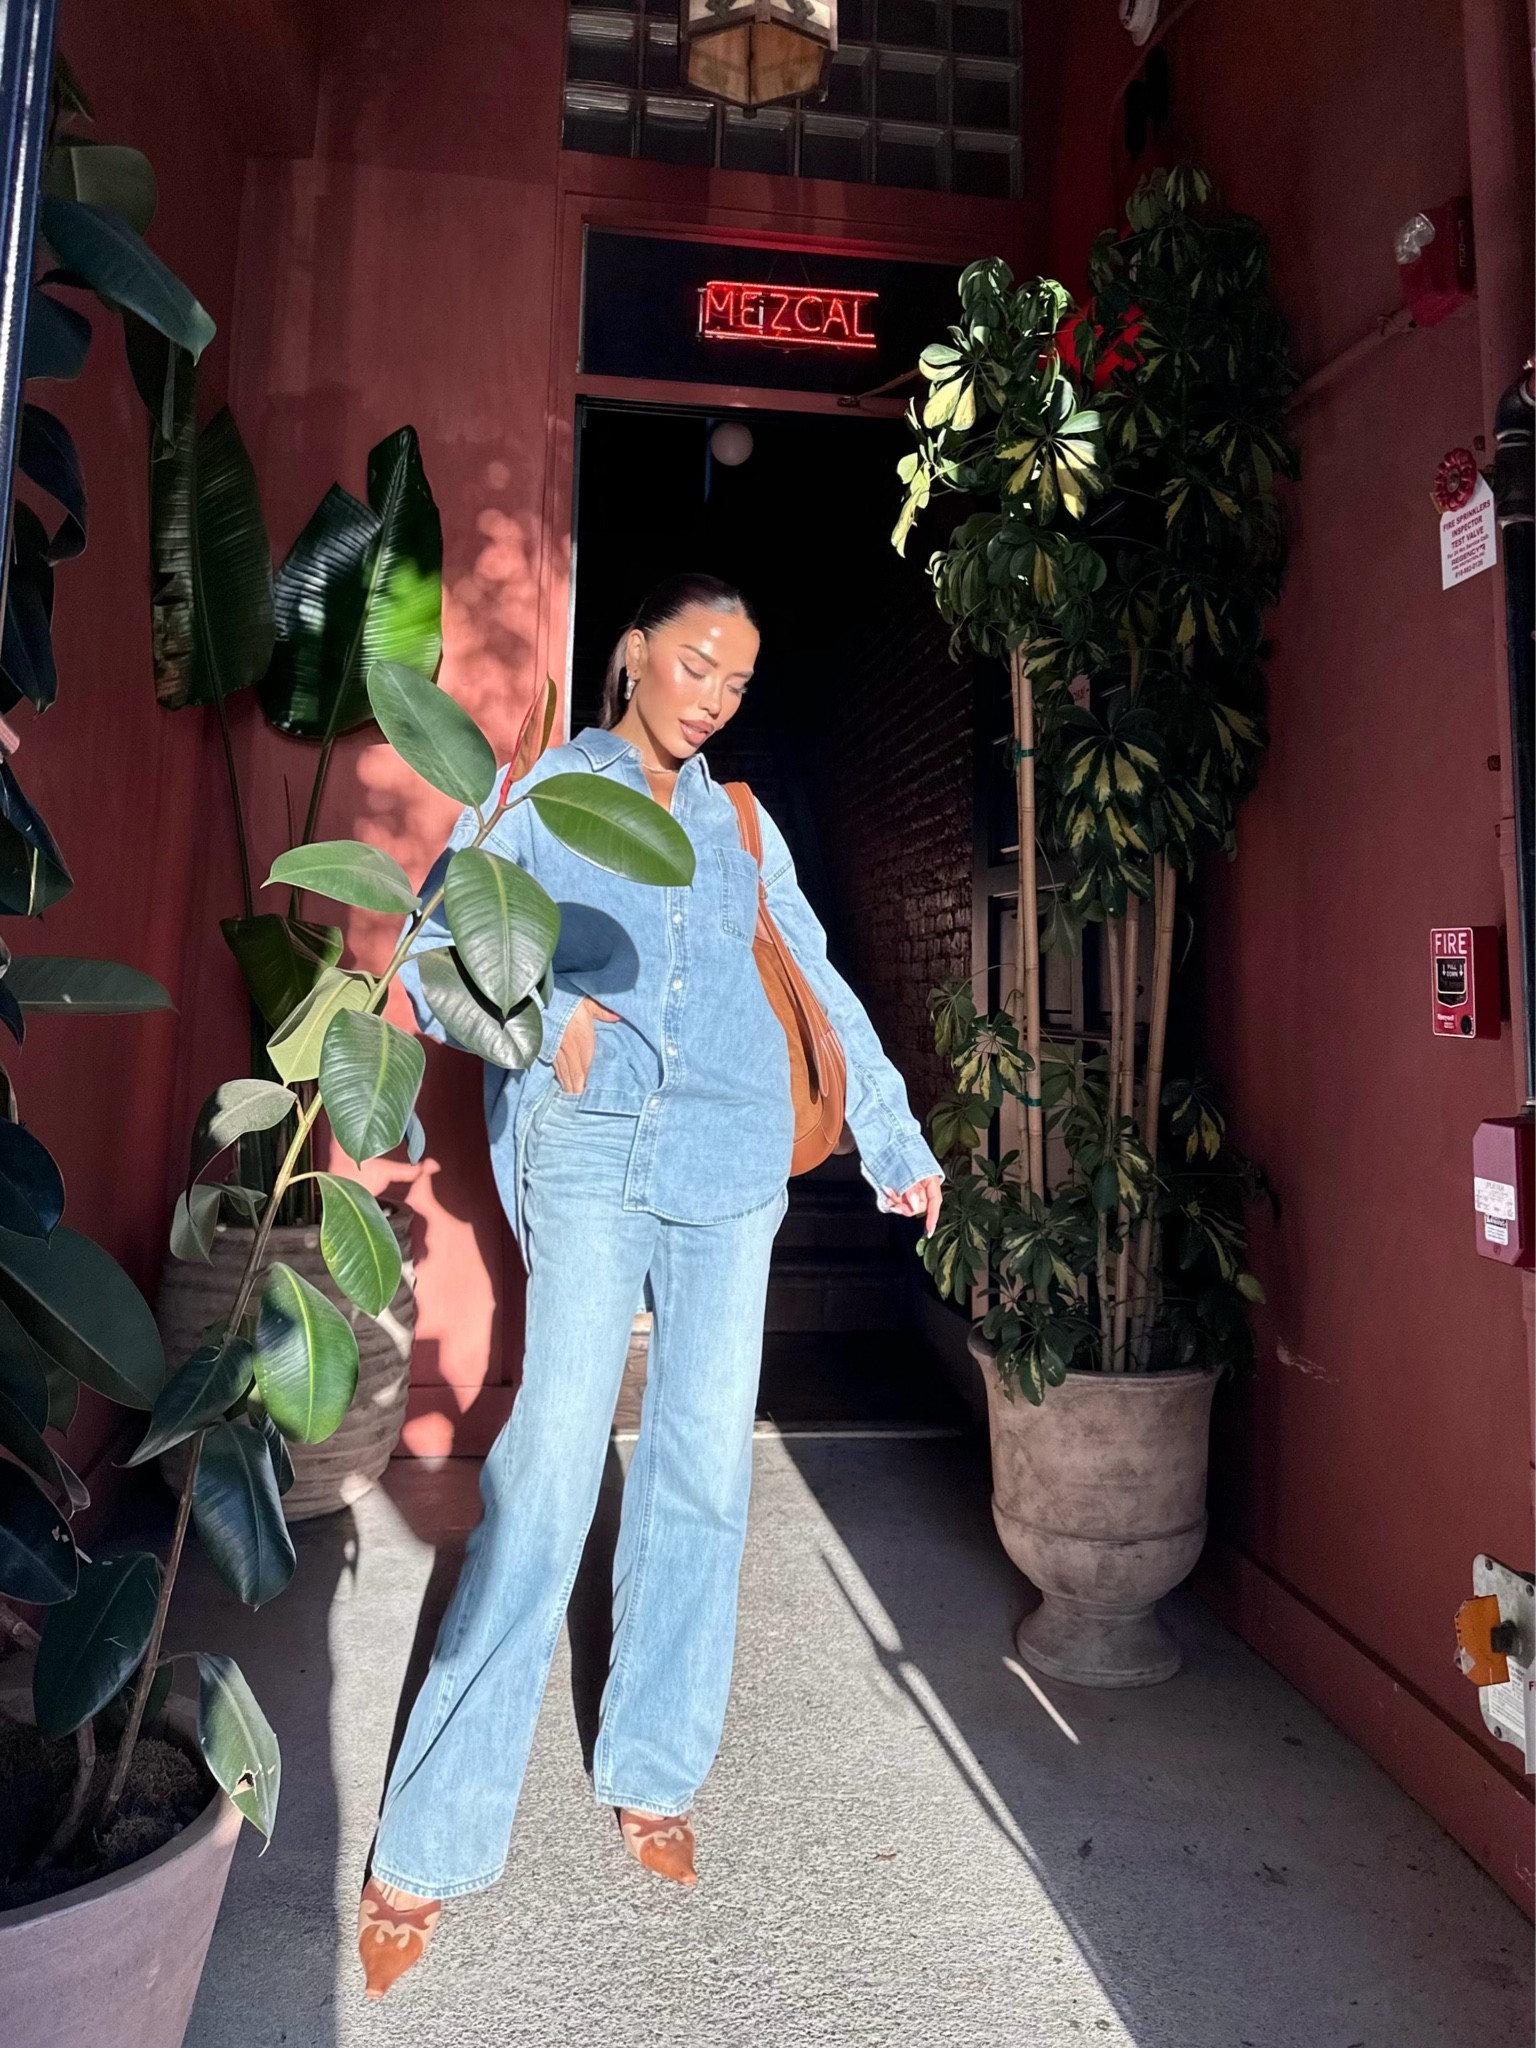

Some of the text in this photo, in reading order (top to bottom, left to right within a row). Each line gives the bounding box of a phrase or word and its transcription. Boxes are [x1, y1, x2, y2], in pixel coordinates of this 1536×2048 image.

[1458, 220, 1467, 267] FIRE
[706, 289, 875, 338] MEZCAL
[1443, 500, 1491, 532] FIRE SPRINKLERS
[1452, 515, 1483, 538] INSPECTOR
[1451, 526, 1484, 549] TEST VALVE
[1435, 932, 1468, 954] FIRE
